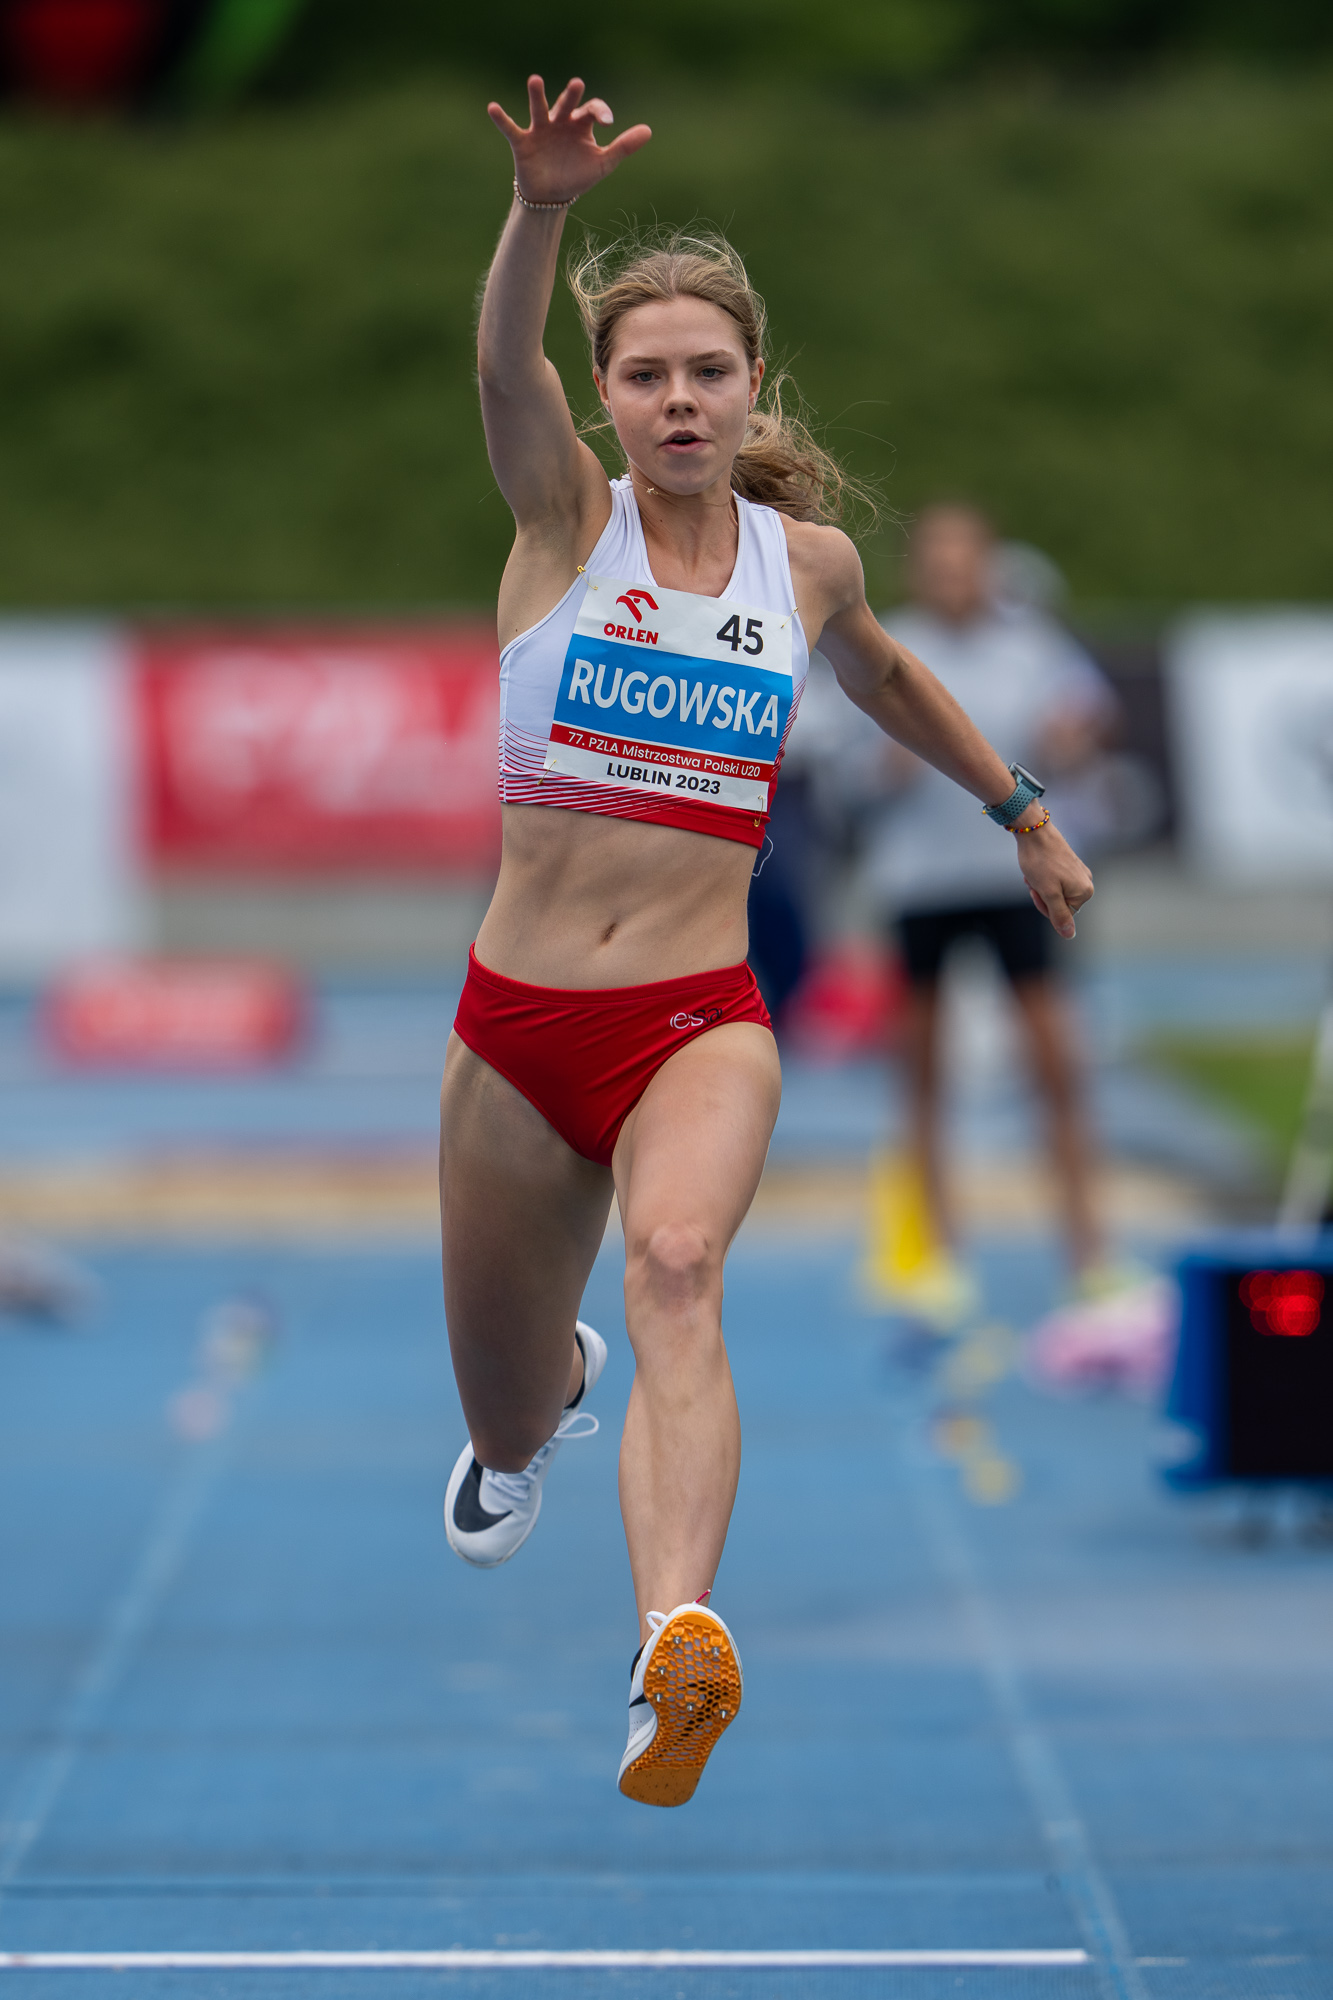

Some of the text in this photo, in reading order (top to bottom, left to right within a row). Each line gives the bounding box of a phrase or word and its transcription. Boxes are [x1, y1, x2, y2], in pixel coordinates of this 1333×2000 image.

[604, 623, 659, 645] ORLEN
[716, 614, 764, 656] 45
[567, 658, 779, 738] RUGOWSKA
[568, 731, 761, 778] 77. PZLA Mistrzostwa Polski U20
[606, 762, 721, 795] LUBLIN 2023
